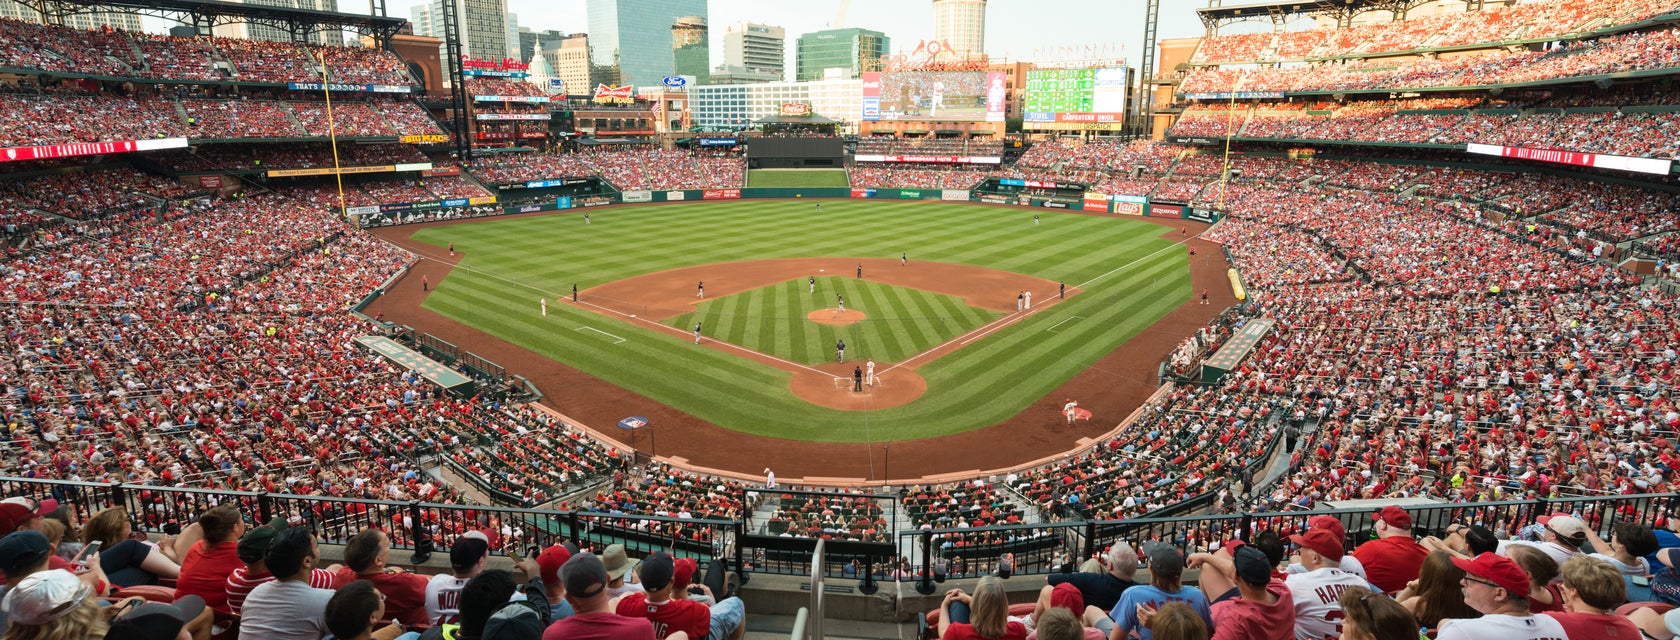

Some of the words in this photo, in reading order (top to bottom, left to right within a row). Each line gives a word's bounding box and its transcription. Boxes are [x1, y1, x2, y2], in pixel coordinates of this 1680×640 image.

[499, 57, 529, 72] Nation
[881, 54, 989, 72] Budweiser
[1036, 61, 1066, 69] WORLD
[1066, 60, 1116, 69] CHAMPIONS
[595, 88, 633, 96] Budweiser
[785, 104, 804, 113] Coca-Cola
[1030, 112, 1048, 120] STIFEL
[405, 135, 421, 143] BIG
[57, 144, 101, 157] CARPENTER
[105, 142, 115, 152] 13
[1530, 150, 1561, 163] CARPENTER
[1565, 153, 1573, 163] 13
[1152, 207, 1180, 215] EQUIFAX
